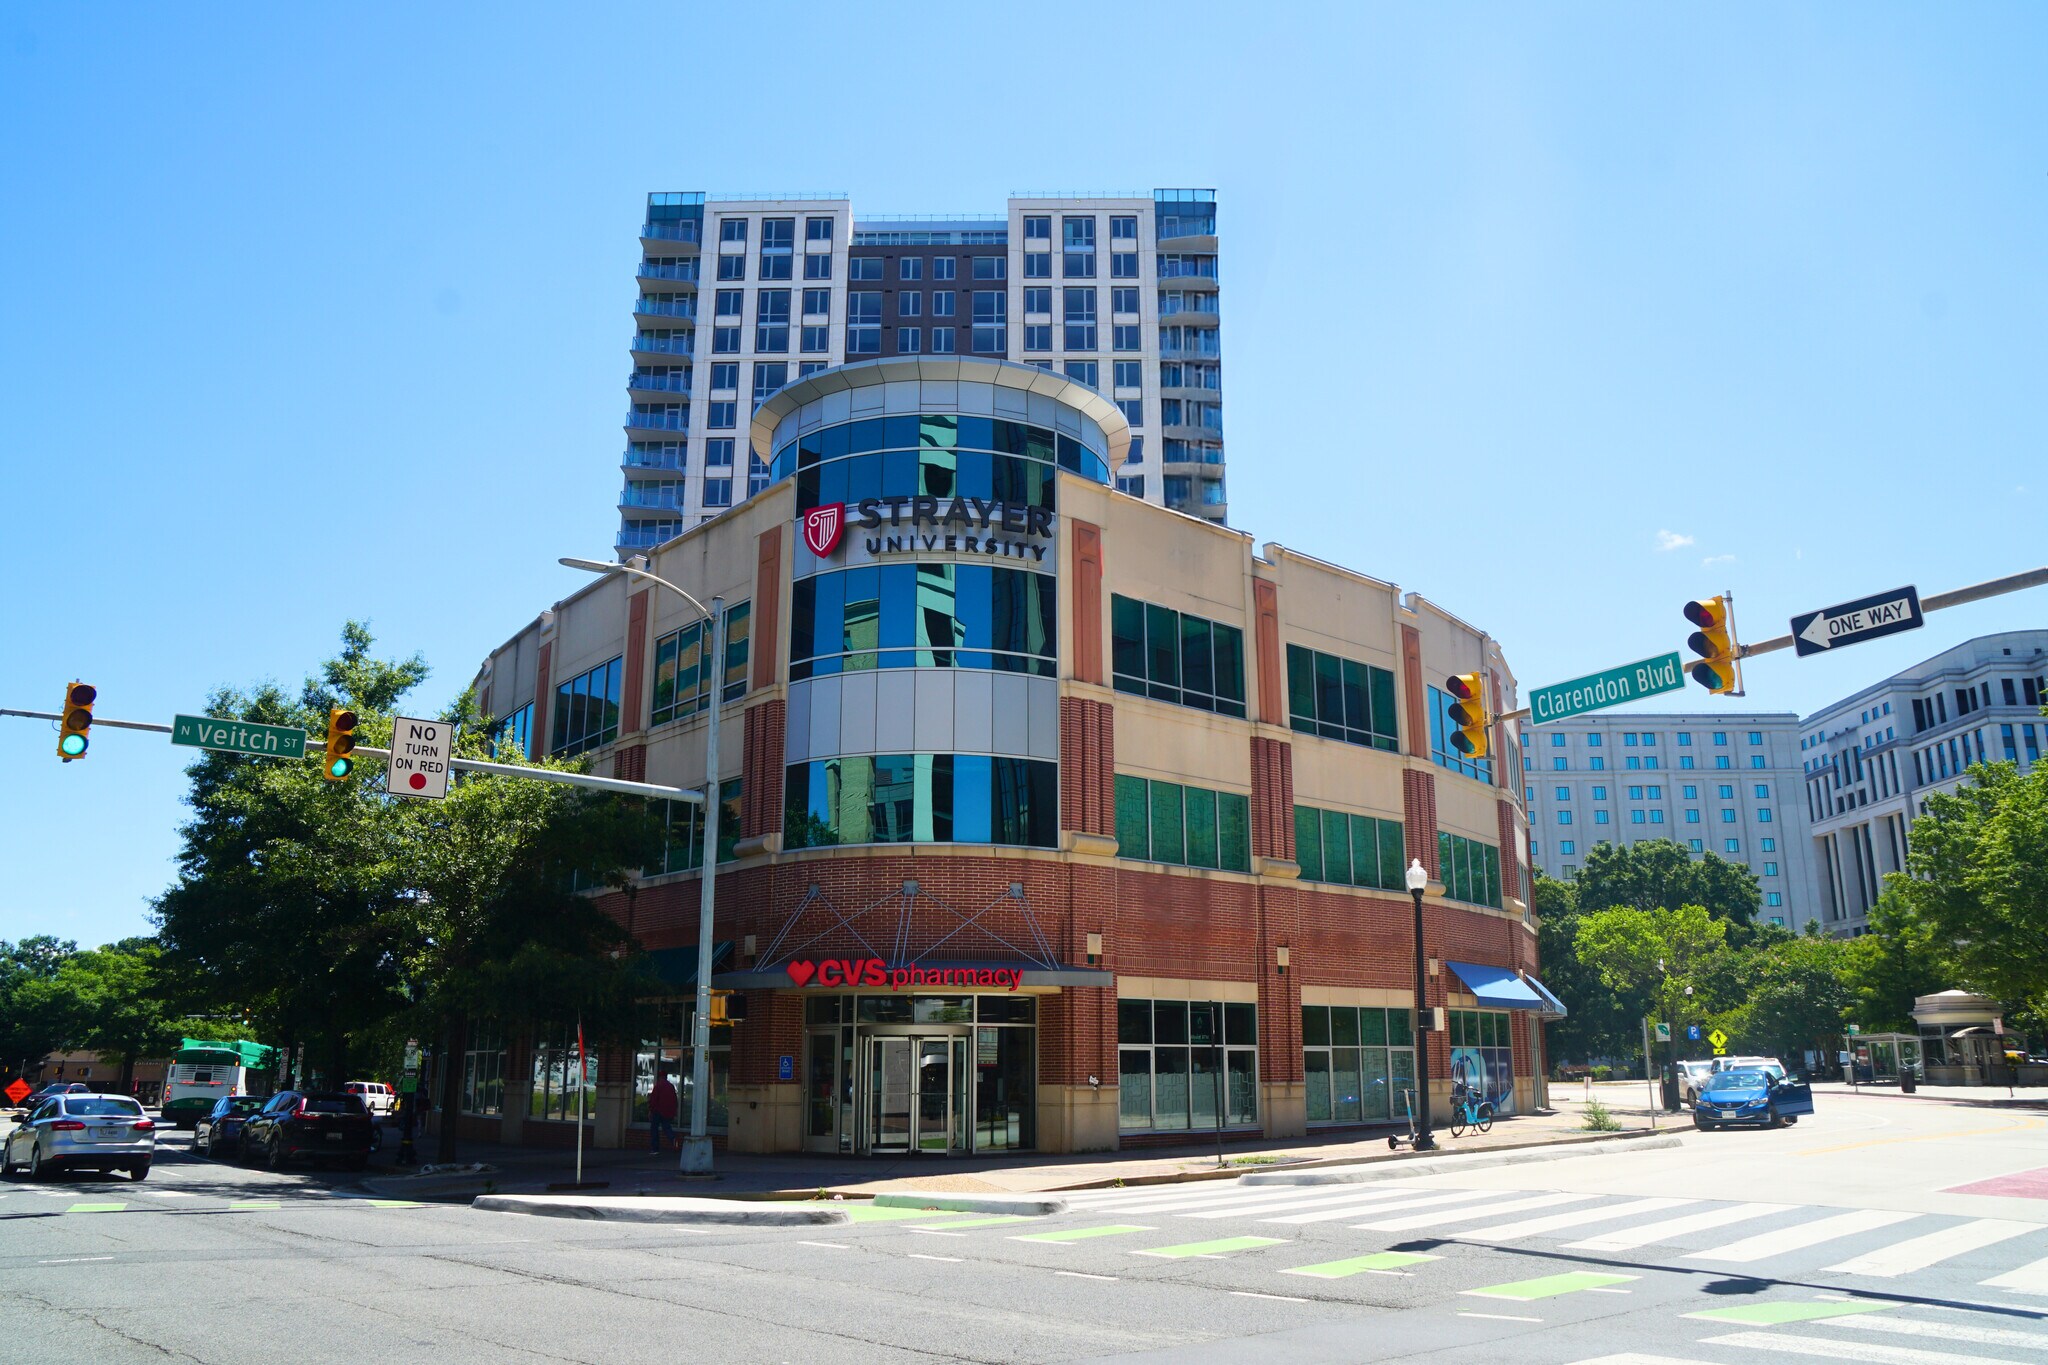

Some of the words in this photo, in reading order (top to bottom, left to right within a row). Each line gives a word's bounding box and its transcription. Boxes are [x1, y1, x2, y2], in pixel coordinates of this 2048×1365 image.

[857, 495, 1052, 538] STRAYER
[866, 534, 1047, 562] UNIVERSITY
[1828, 616, 1866, 636] ONE
[1868, 600, 1906, 625] WAY
[1537, 677, 1631, 718] Clarendon
[1636, 659, 1678, 692] Blvd
[180, 725, 191, 737] N
[198, 723, 278, 751] Veitch
[283, 738, 298, 749] ST
[408, 725, 437, 742] NO
[405, 743, 439, 758] TURN
[395, 757, 415, 772] ON
[419, 760, 444, 774] RED
[817, 958, 888, 988] CVS
[892, 963, 1024, 992] pharmacy
